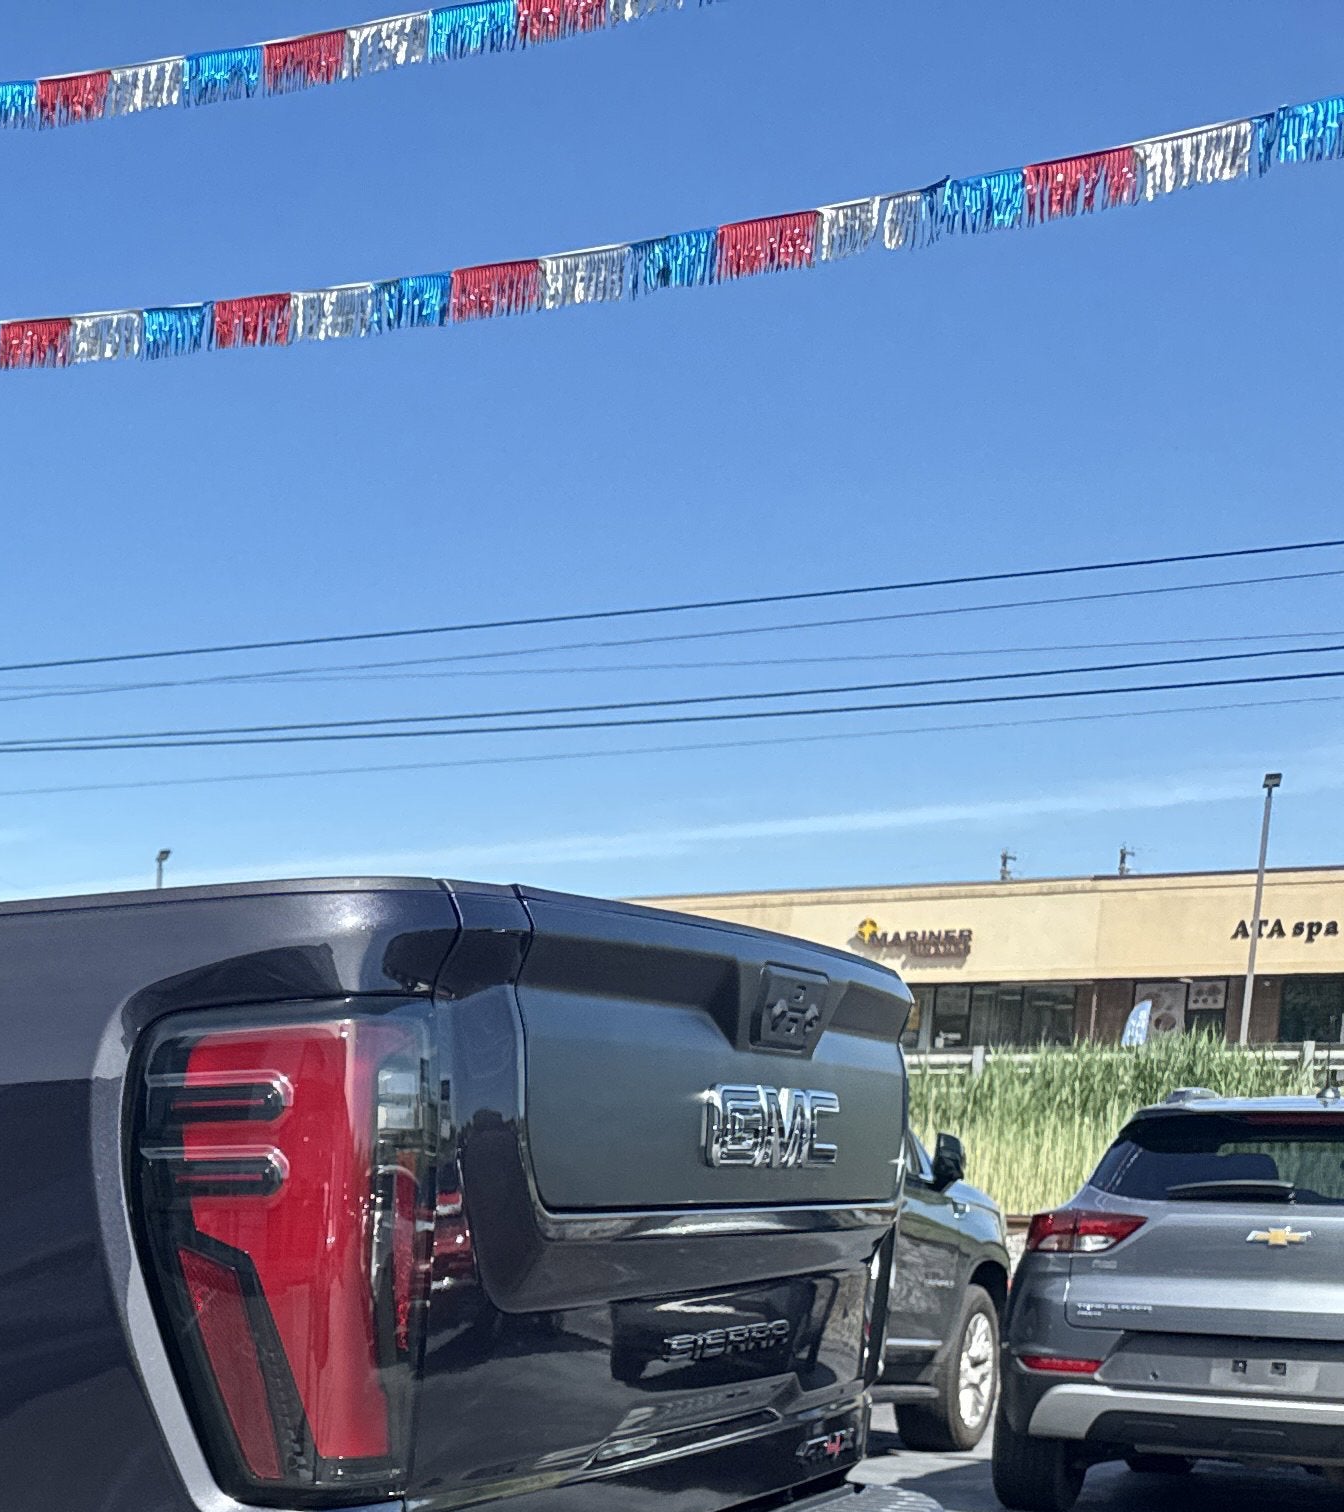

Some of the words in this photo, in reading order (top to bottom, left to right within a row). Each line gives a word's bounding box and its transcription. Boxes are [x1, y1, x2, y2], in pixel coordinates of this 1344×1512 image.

[869, 928, 973, 946] MARINER
[1292, 920, 1339, 943] spa
[700, 1083, 841, 1168] GMC
[662, 1319, 790, 1360] SIERRA
